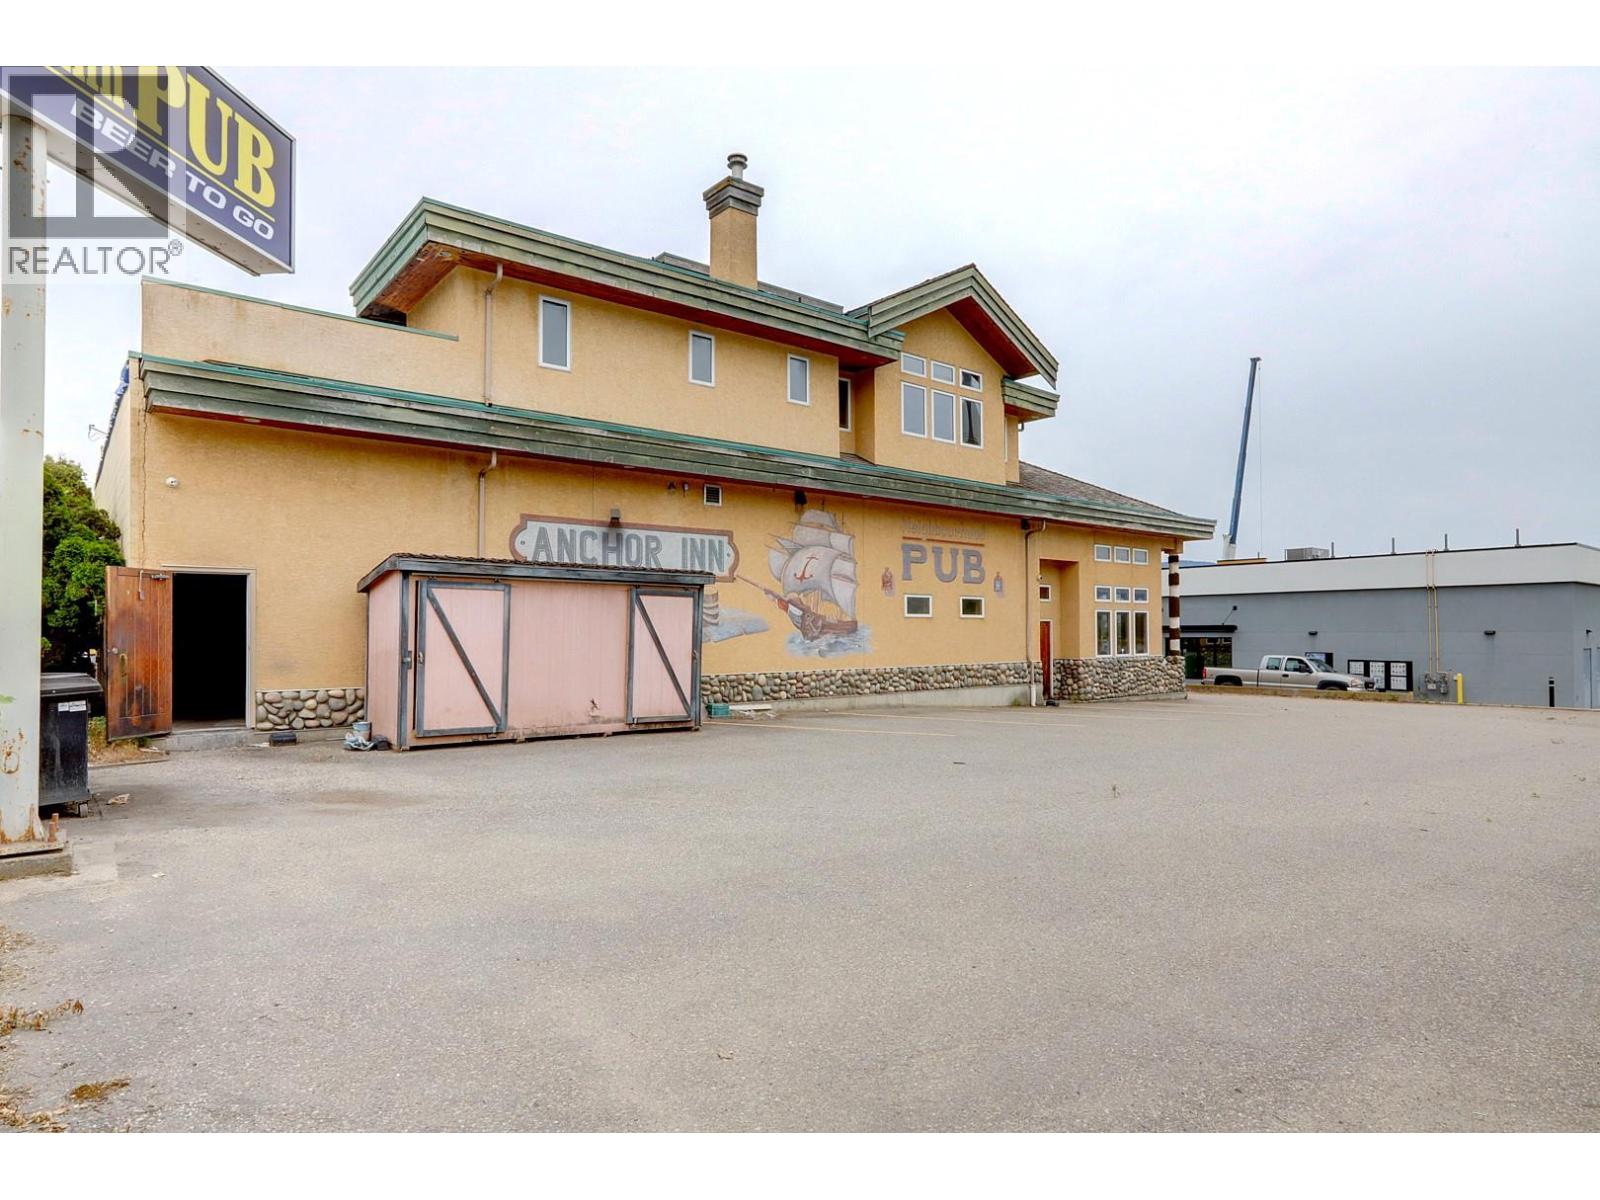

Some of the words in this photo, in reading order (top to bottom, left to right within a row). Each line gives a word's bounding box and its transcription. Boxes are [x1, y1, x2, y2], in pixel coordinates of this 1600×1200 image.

[70, 97, 177, 180] BEER
[185, 170, 227, 210] TO
[232, 205, 275, 240] GO
[133, 66, 276, 208] PUB
[531, 526, 663, 569] ANCHOR
[681, 537, 726, 574] INN
[901, 543, 986, 585] PUB
